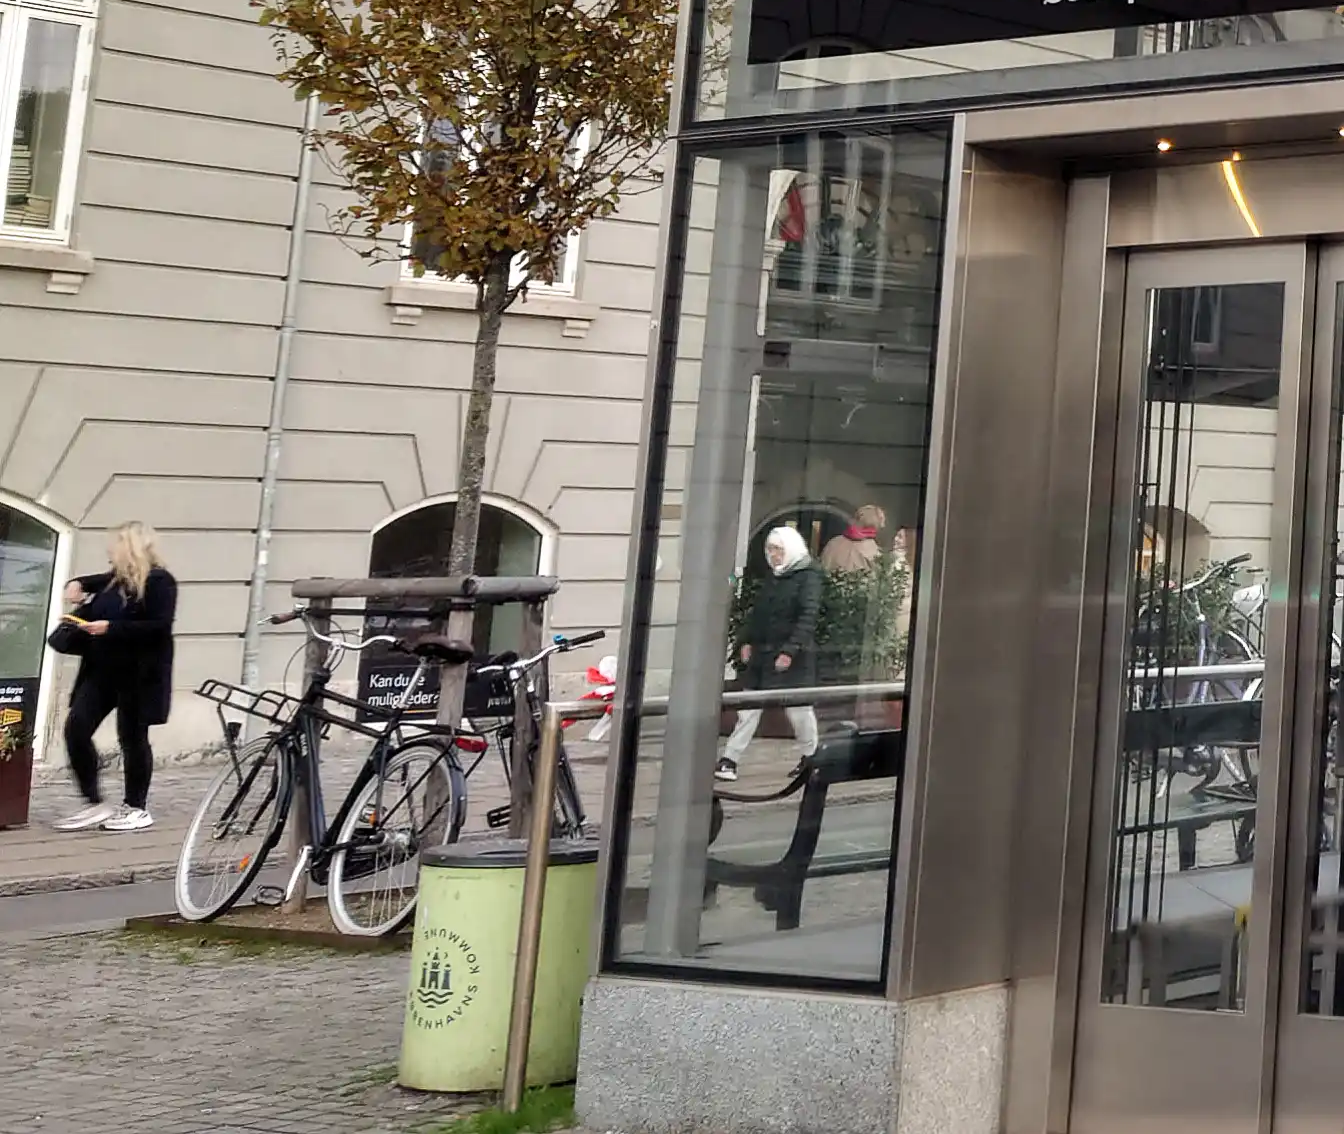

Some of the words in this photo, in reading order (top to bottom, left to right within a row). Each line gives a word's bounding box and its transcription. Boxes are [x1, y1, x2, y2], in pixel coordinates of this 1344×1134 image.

[369, 674, 392, 688] Kan
[394, 673, 410, 687] du
[424, 928, 480, 974] KOMMUNE
